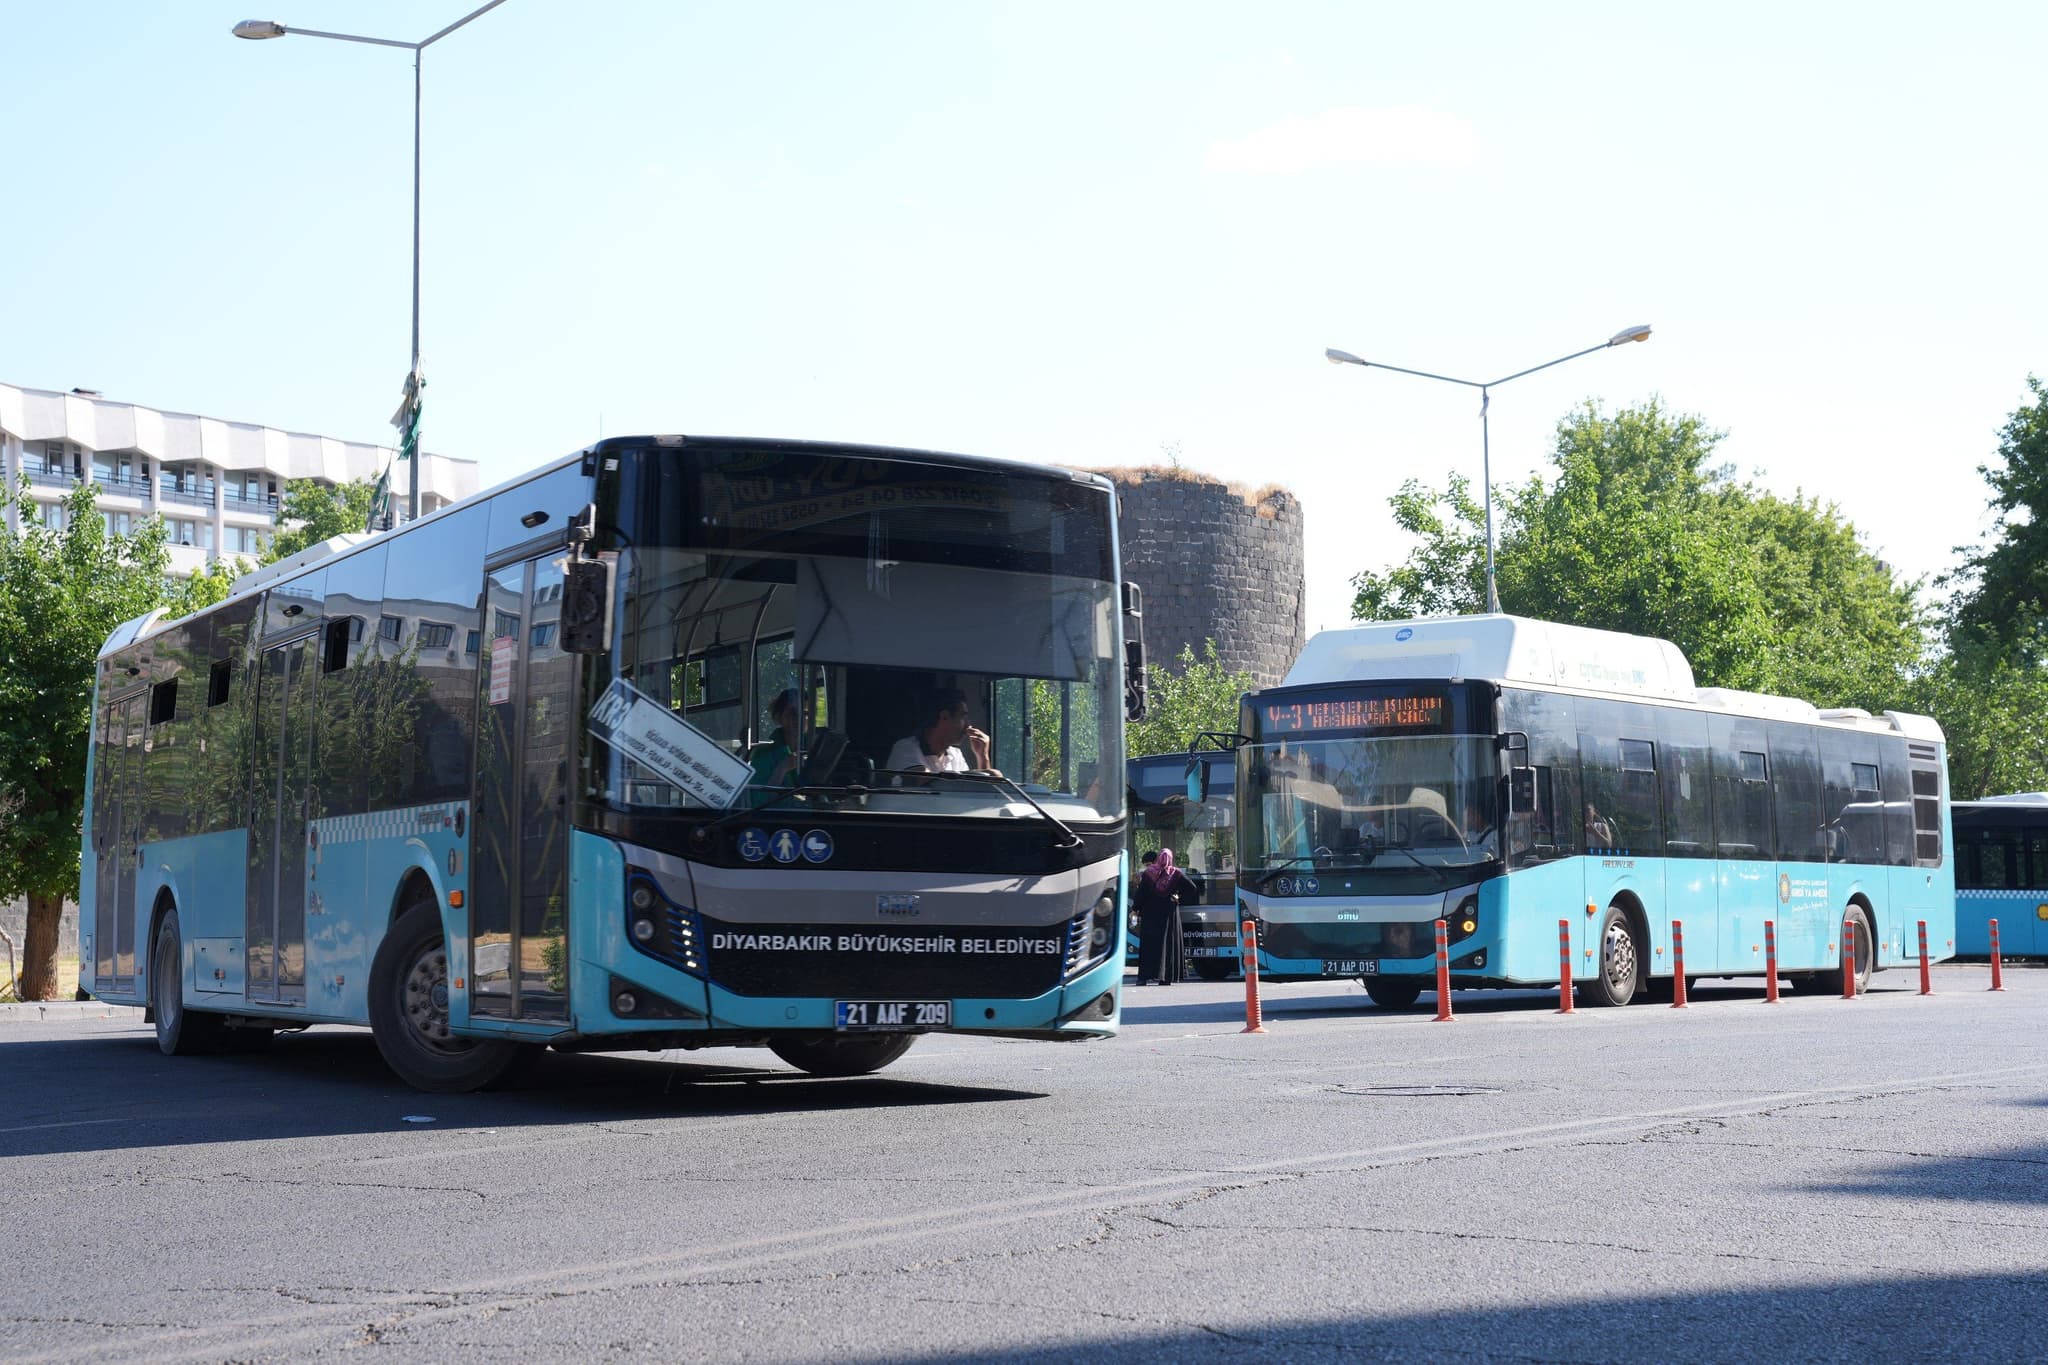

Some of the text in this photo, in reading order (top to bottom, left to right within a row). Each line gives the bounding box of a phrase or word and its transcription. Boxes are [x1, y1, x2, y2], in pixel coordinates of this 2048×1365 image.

[712, 932, 1061, 955] DİYARBAKIR BÜYÜKŞEHİR BELEDİYESİ
[1327, 961, 1375, 972] 21 AAP 015
[846, 1003, 946, 1024] 21 AAF 209
